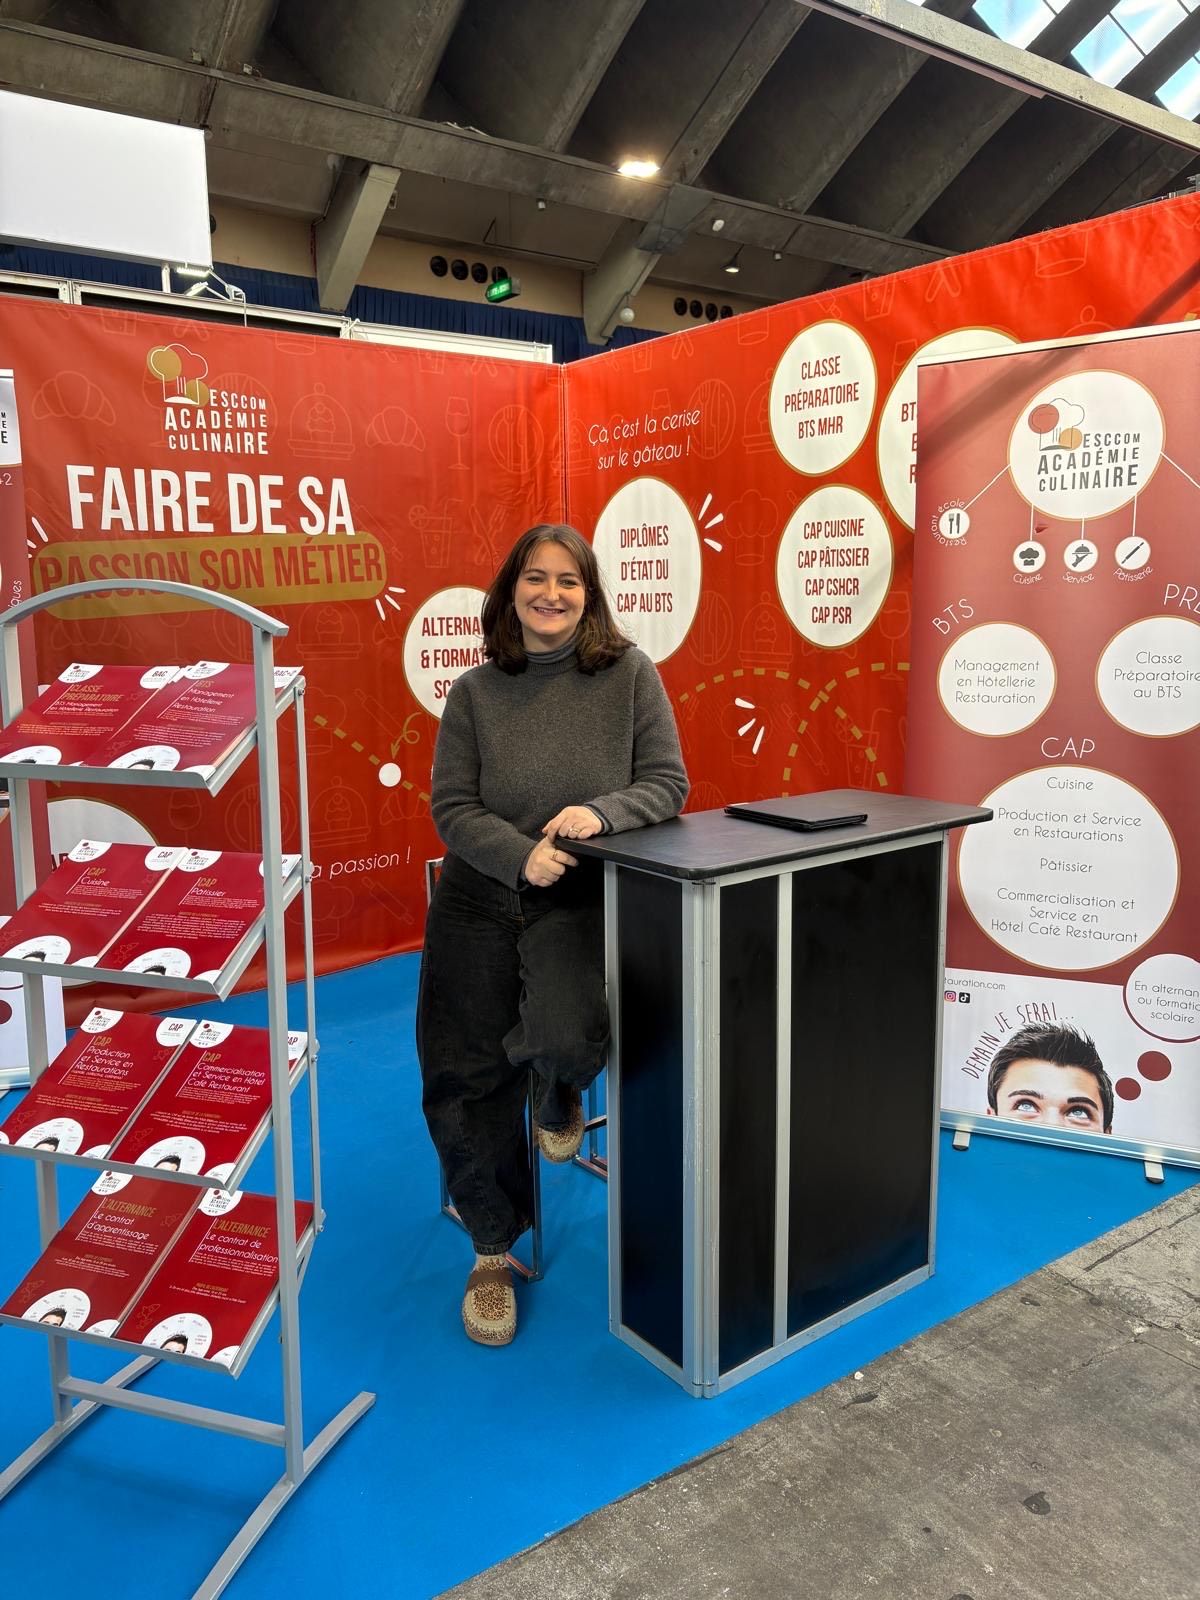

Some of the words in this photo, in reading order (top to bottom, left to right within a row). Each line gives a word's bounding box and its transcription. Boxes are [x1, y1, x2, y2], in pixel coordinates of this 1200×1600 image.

[801, 356, 841, 380] CLASSE
[209, 388, 266, 410] ESCCOM
[784, 381, 860, 413] PRÉPARATOIRE
[165, 406, 267, 431] ACADÉMIE
[901, 402, 917, 422] BT
[613, 418, 639, 439] c'est
[644, 414, 657, 436] la
[662, 409, 701, 430] cerise
[798, 418, 816, 439] BTS
[818, 416, 843, 436] MHR
[168, 432, 268, 455] CULINAIRE
[1082, 432, 1141, 449] ESCCOM
[597, 452, 615, 470] sur
[618, 448, 628, 468] le
[633, 444, 681, 469] gâteau
[1037, 446, 1140, 475] ACADÉMIE
[1039, 464, 1138, 492] CULINAIRE
[66, 464, 214, 532] FAIRE
[227, 473, 287, 534] DE
[298, 476, 356, 536] SA
[937, 498, 965, 513] école
[620, 525, 669, 549] DIPLÔMES
[804, 520, 823, 540] CAP
[825, 518, 865, 538] CUISINE
[930, 515, 968, 547] Restaurant
[798, 549, 818, 569] CAP
[820, 545, 869, 568] PÂTISSIER
[39, 550, 190, 600] PASSION
[200, 548, 266, 592] SON
[274, 537, 383, 587] MÉTIER
[620, 557, 654, 581] D'ÉTAT
[655, 559, 669, 580] DU
[1062, 571, 1094, 585] Service
[1113, 565, 1153, 582] Pâtisserie
[805, 578, 825, 596] CAP
[826, 577, 859, 596] CSHCR
[1012, 573, 1043, 585] Cuisine
[617, 593, 637, 613] CAP
[639, 593, 653, 612] AU
[655, 592, 673, 613] BTS
[811, 606, 830, 625] CAP
[832, 605, 852, 624] PSR
[932, 598, 974, 635] BTS
[422, 616, 484, 637] ALTERNA
[421, 649, 430, 669] &
[433, 647, 489, 668] FORMAT
[954, 658, 1040, 673] Management
[1136, 651, 1182, 664] Classe
[957, 678, 972, 687] en
[977, 675, 1036, 688] Hôtellerie
[1114, 668, 1200, 682] Préparatoire
[434, 679, 455, 699] SC
[955, 690, 1036, 704] Restauration
[1133, 688, 1152, 698] au
[1157, 685, 1182, 699] BTS
[1041, 736, 1095, 759] CAP
[1046, 776, 1094, 791] Cuisine
[998, 807, 1068, 823] Production
[1073, 812, 1086, 824] et
[1092, 812, 1142, 827] Service
[1013, 827, 1029, 837] en
[1034, 825, 1124, 843] Restaurations
[157, 851, 173, 859] CAP
[87, 868, 106, 876] CAP
[330, 853, 399, 880] passion
[1040, 858, 1093, 874] Pâtissier
[80, 876, 110, 887] Cuisine
[197, 877, 218, 888] CAP
[997, 887, 1116, 909] Commercialisation
[1121, 898, 1136, 910] et
[1029, 906, 1077, 922] Service
[1082, 912, 1099, 924] en
[991, 919, 1023, 934] Hôtel
[1028, 921, 1061, 937] Café
[1066, 925, 1138, 943] Restaurant
[944, 977, 1006, 991] tauration.com
[1134, 981, 1147, 991] En
[1152, 984, 1200, 998] alternan
[1137, 997, 1151, 1005] ou
[1156, 996, 1200, 1011] formatio
[1151, 1011, 1194, 1024] scolaire
[168, 1023, 184, 1032] CAP
[93, 1036, 112, 1047] CAP
[961, 1031, 1000, 1080] DEMAIN
[994, 1011, 1013, 1033] JE
[87, 1045, 131, 1059] Production
[92, 1056, 121, 1067] Service
[202, 1052, 221, 1063] CAP
[74, 1061, 129, 1076] Restaurations
[196, 1062, 265, 1078] Commercialisation
[202, 1072, 229, 1082] Service
[208, 1081, 250, 1093] Restaurant
[101, 1198, 157, 1218] L'ALTERNANCE
[93, 1211, 101, 1219] Le
[105, 1214, 135, 1225] contrat
[86, 1221, 150, 1240] d'apprentissage
[212, 1219, 271, 1239] L'ALTERNANCE
[205, 1232, 217, 1240] Le
[217, 1234, 249, 1246] contrat
[249, 1240, 262, 1249] de
[198, 1243, 279, 1263] professionnalisation
